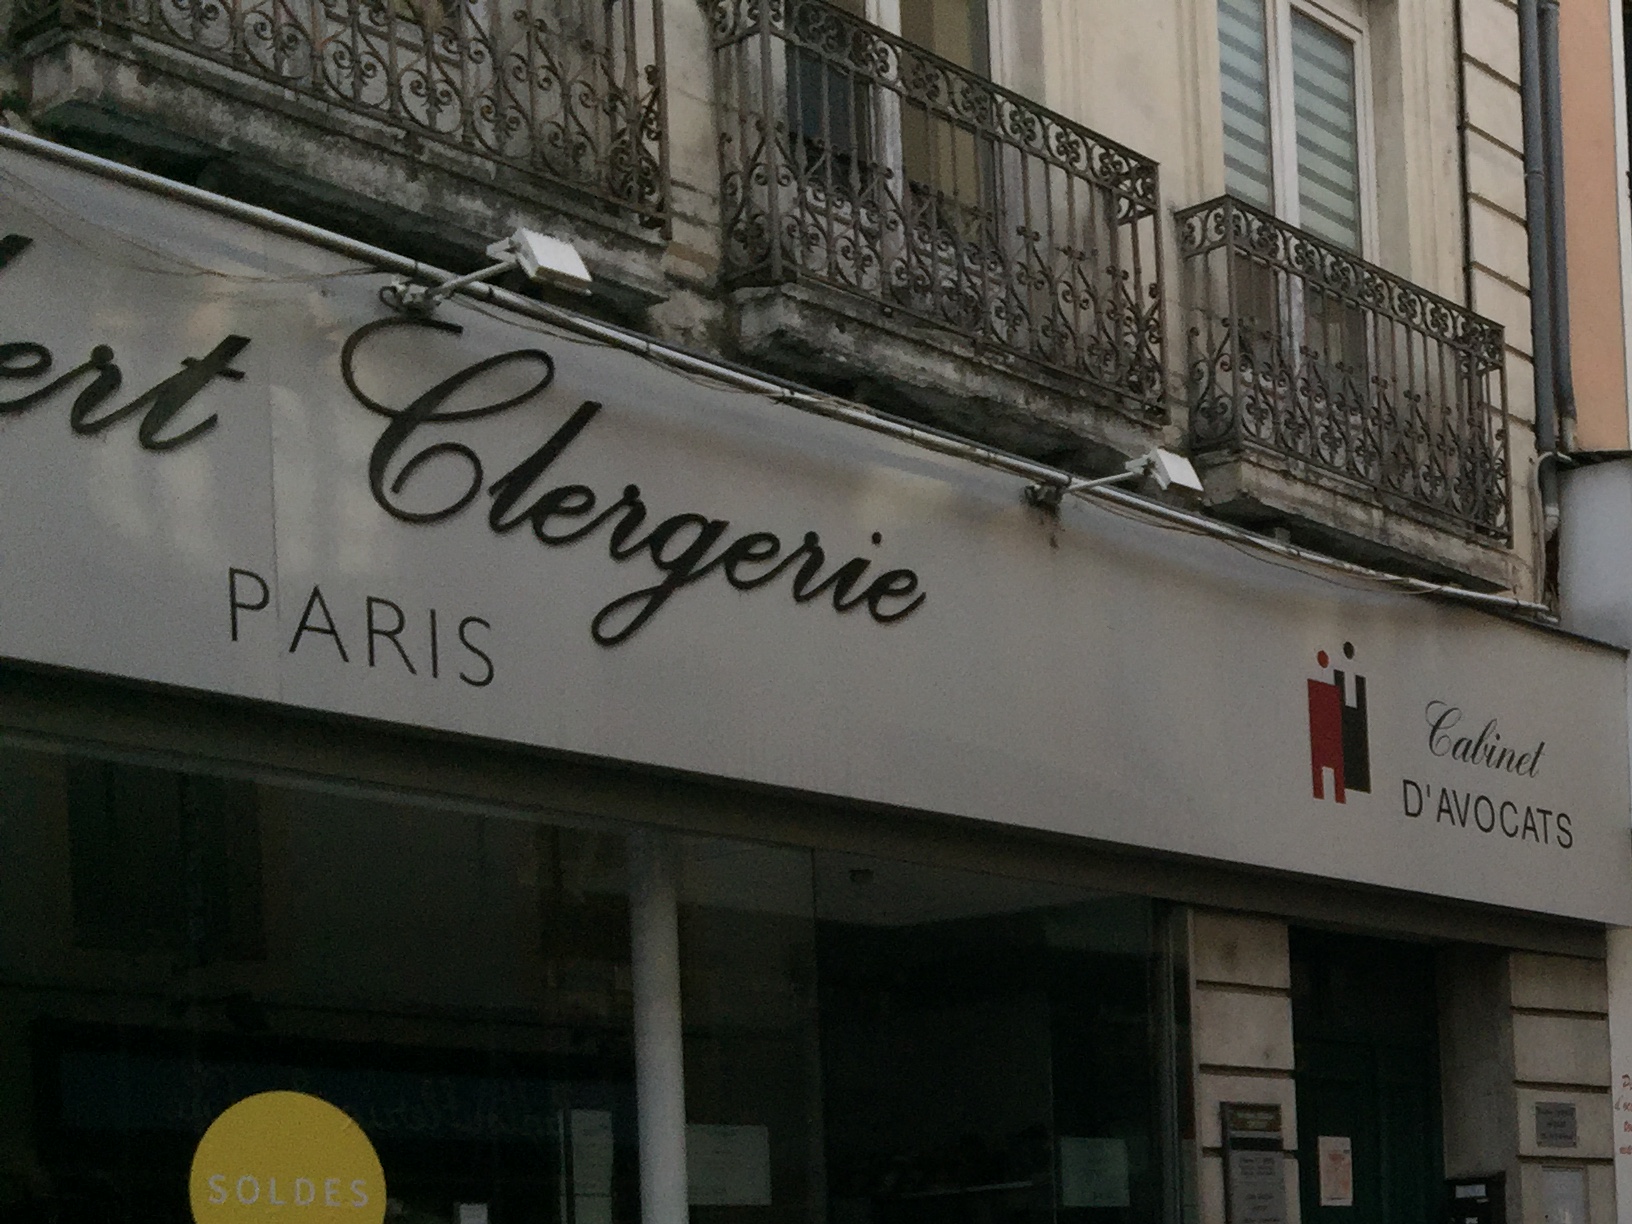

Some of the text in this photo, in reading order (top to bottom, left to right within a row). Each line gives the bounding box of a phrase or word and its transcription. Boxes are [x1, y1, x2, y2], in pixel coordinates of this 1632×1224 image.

[0, 234, 927, 647] ert Clergerie
[228, 567, 495, 688] PARIS
[1424, 699, 1546, 779] Cabinet
[1402, 779, 1574, 849] D'AVOCATS
[208, 1173, 370, 1209] SOLDES
